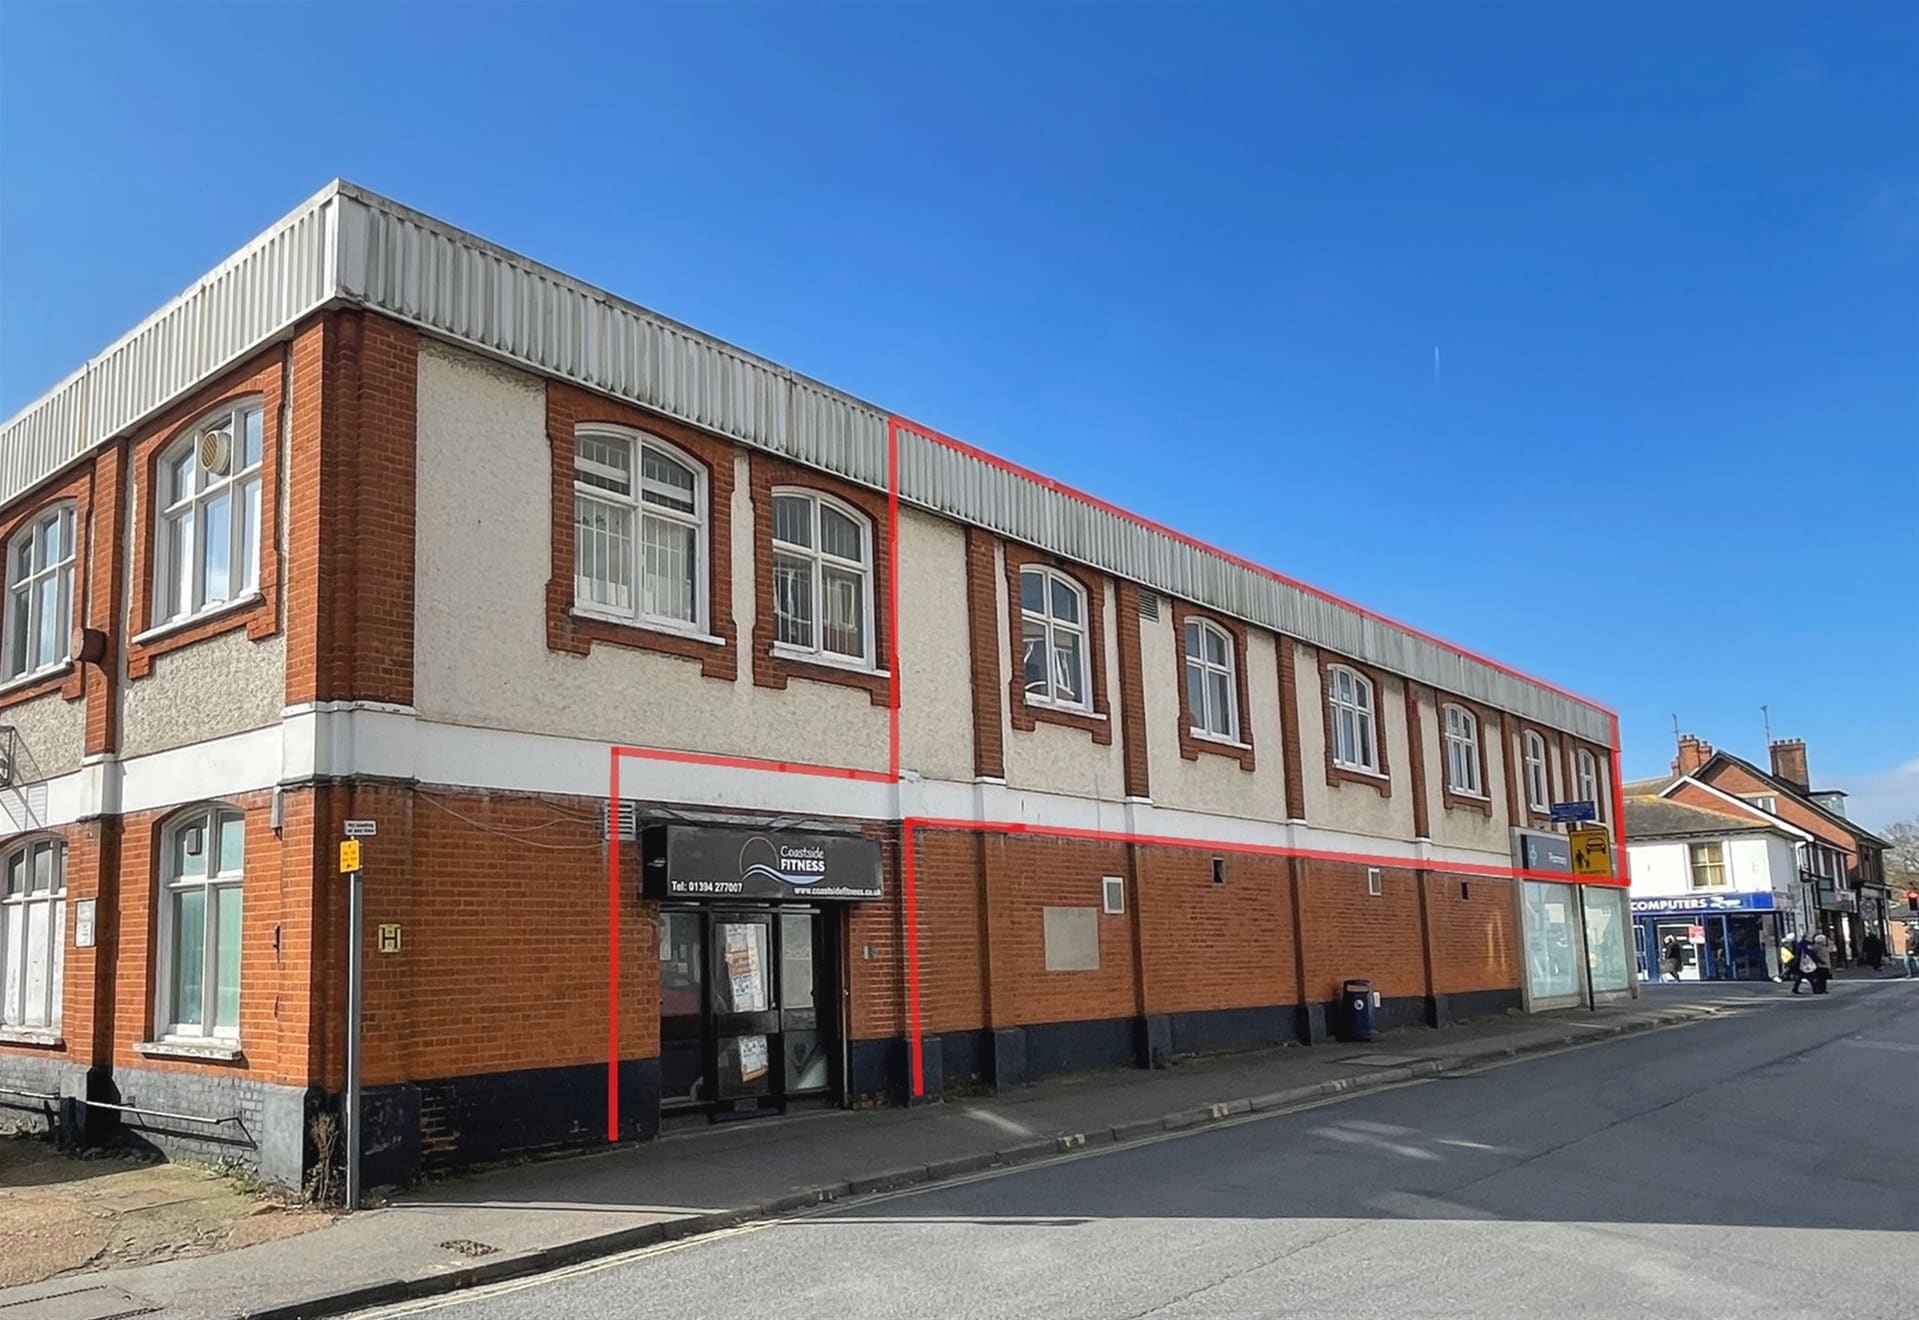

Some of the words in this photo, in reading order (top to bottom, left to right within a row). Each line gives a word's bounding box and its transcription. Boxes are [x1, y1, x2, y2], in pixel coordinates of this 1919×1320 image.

[781, 845, 824, 859] Coastside
[781, 859, 825, 872] FITNESS
[671, 881, 687, 892] Tel:
[688, 881, 713, 892] 01394
[1630, 899, 1708, 911] COMPUTERS
